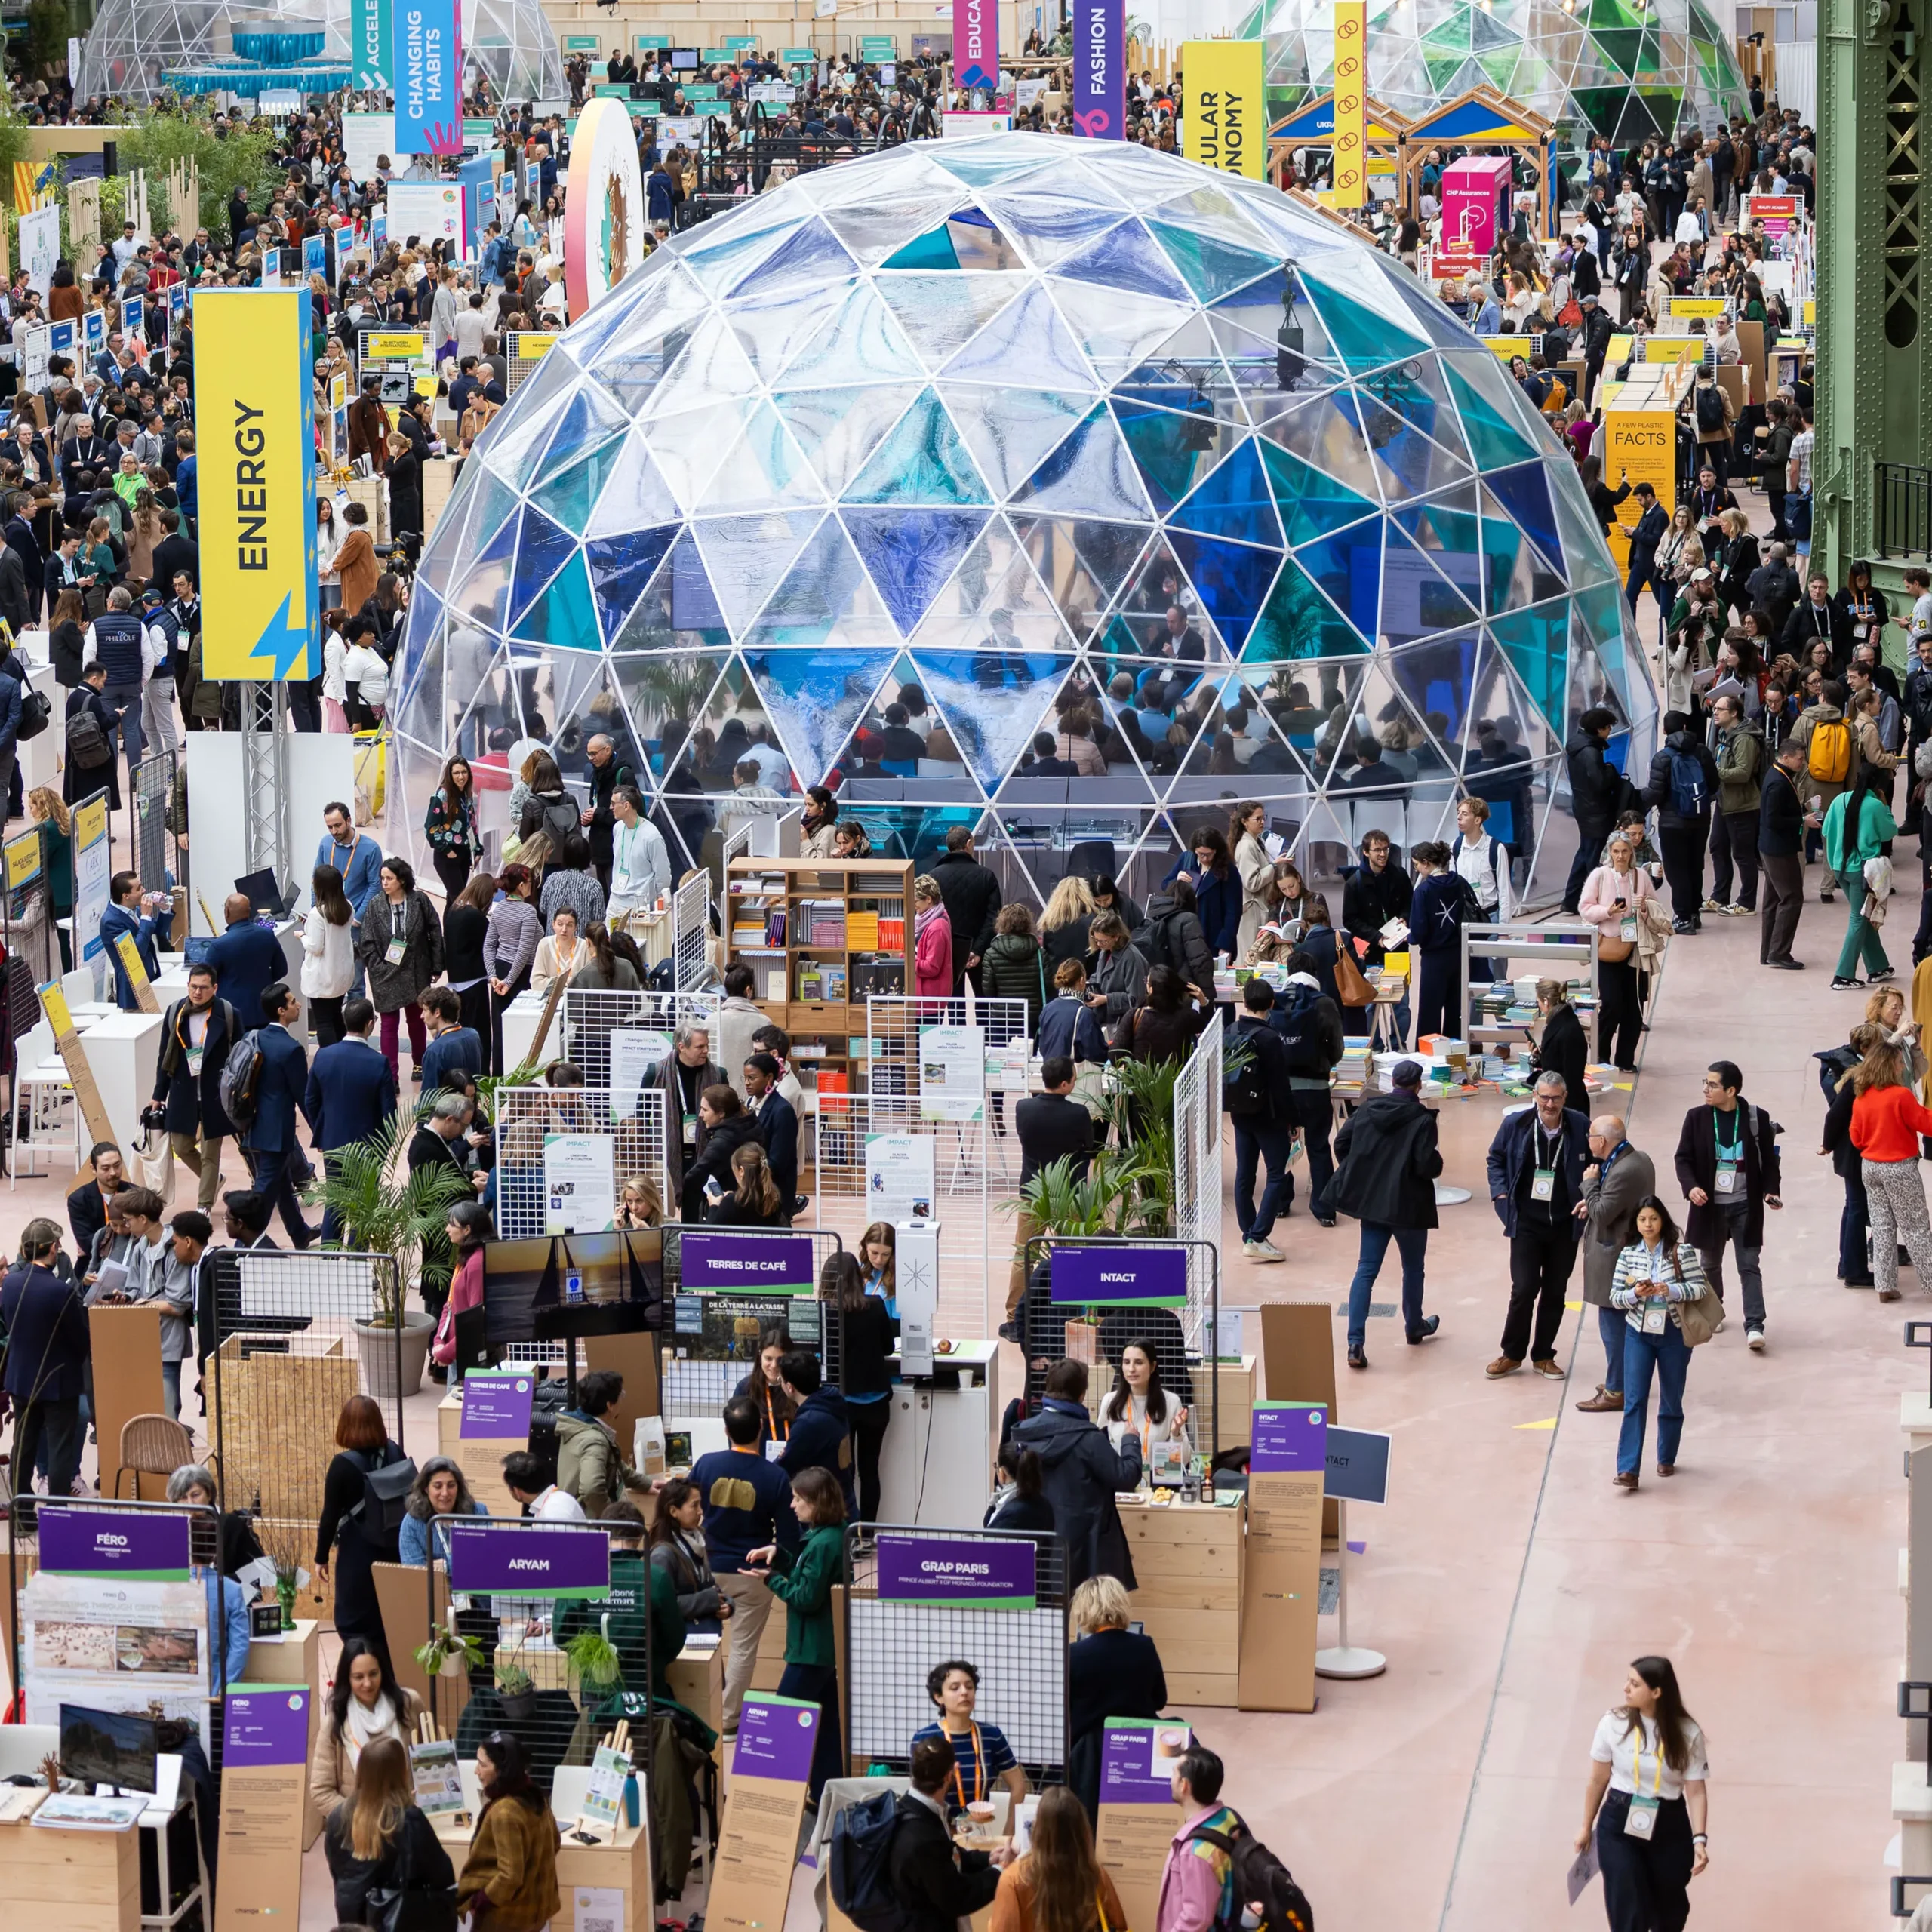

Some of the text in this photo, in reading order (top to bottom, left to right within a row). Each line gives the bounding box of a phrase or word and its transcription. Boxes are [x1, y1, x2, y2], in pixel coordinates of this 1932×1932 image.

[968, 0, 982, 59] EDUCA
[1091, 8, 1106, 95] FASHION
[408, 11, 423, 120] CHANGING
[426, 28, 441, 102] HABITS
[1615, 432, 1666, 445] FACTS
[235, 399, 269, 571] ENERGY
[706, 1259, 786, 1271] TERRES DE CAFÉ
[1100, 1272, 1136, 1282] INTACT
[1325, 1455, 1349, 1466] NTACT
[97, 1532, 128, 1546] FÉRO
[509, 1558, 549, 1571] ARYAM
[921, 1561, 989, 1574] GRAP PARIS
[747, 1708, 768, 1717] ARYAM
